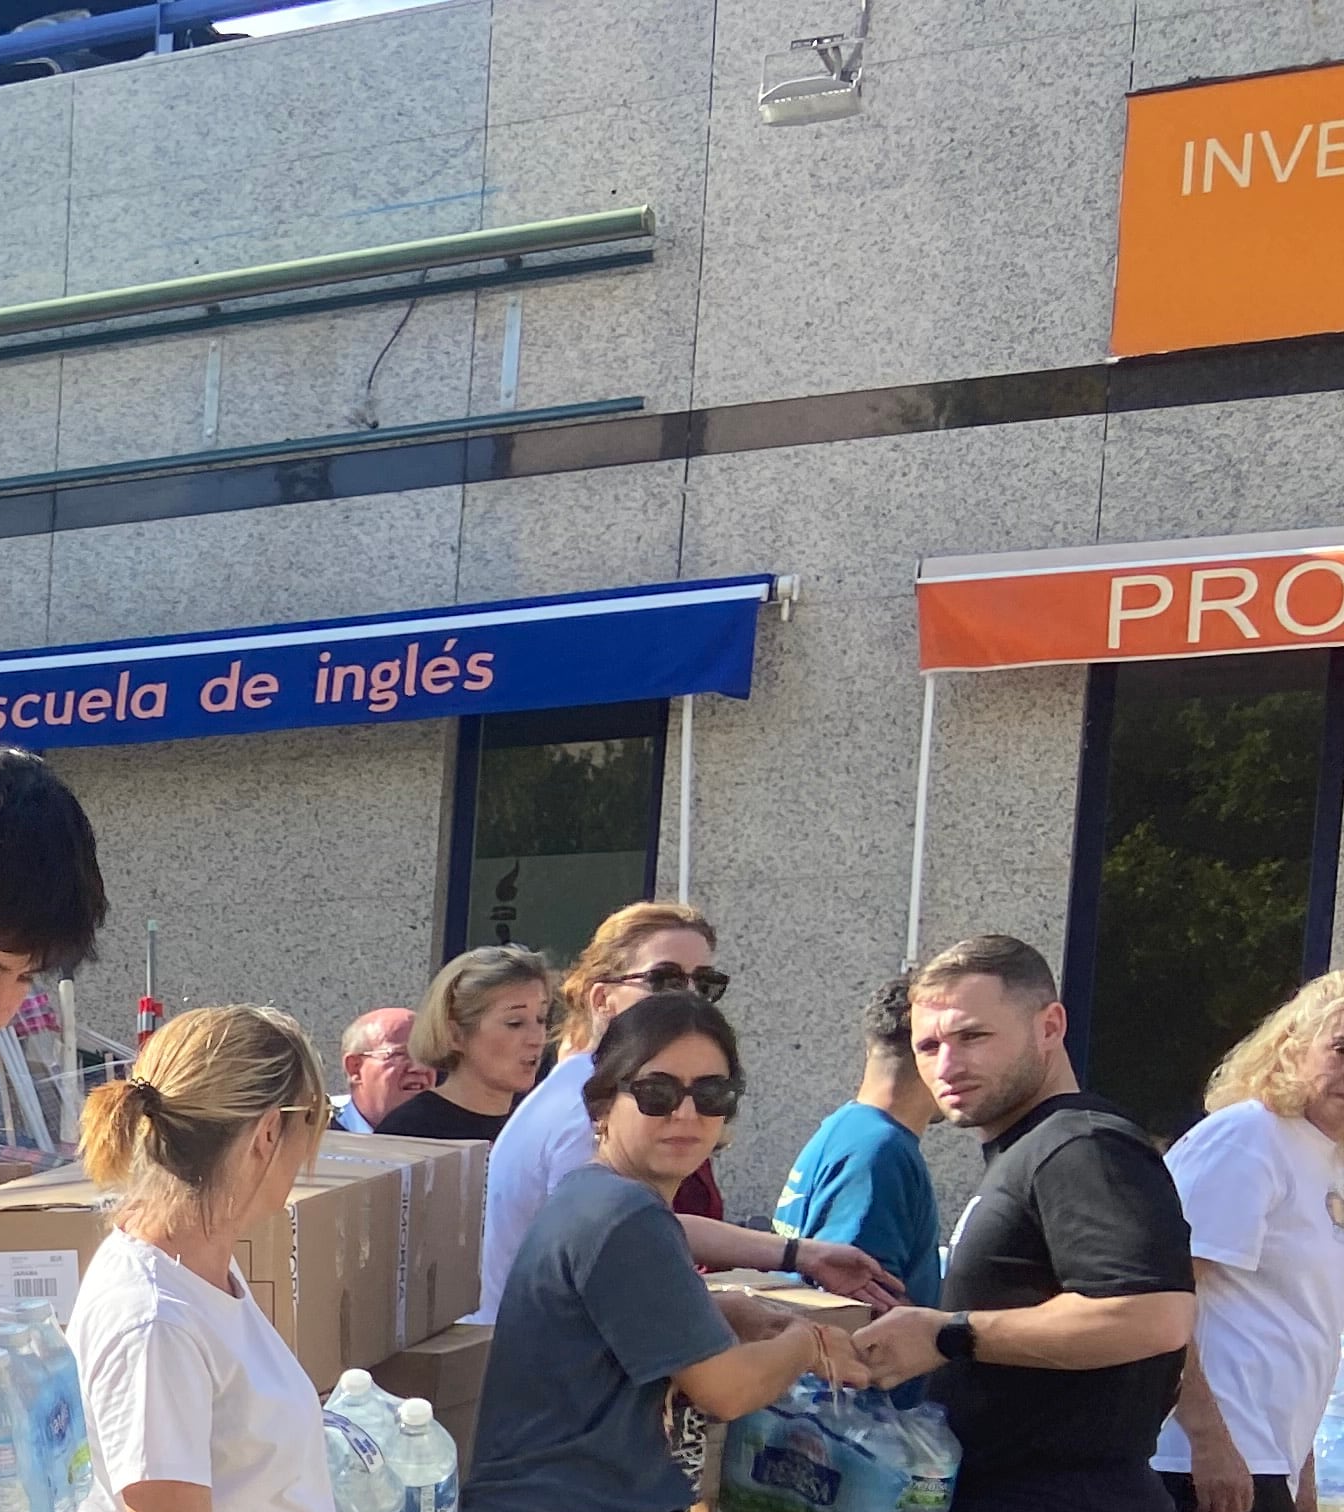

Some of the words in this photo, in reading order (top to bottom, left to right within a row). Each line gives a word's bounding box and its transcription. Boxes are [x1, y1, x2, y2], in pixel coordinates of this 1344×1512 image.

[1106, 558, 1344, 650] PRO
[198, 659, 280, 714] de
[314, 636, 496, 714] inglés
